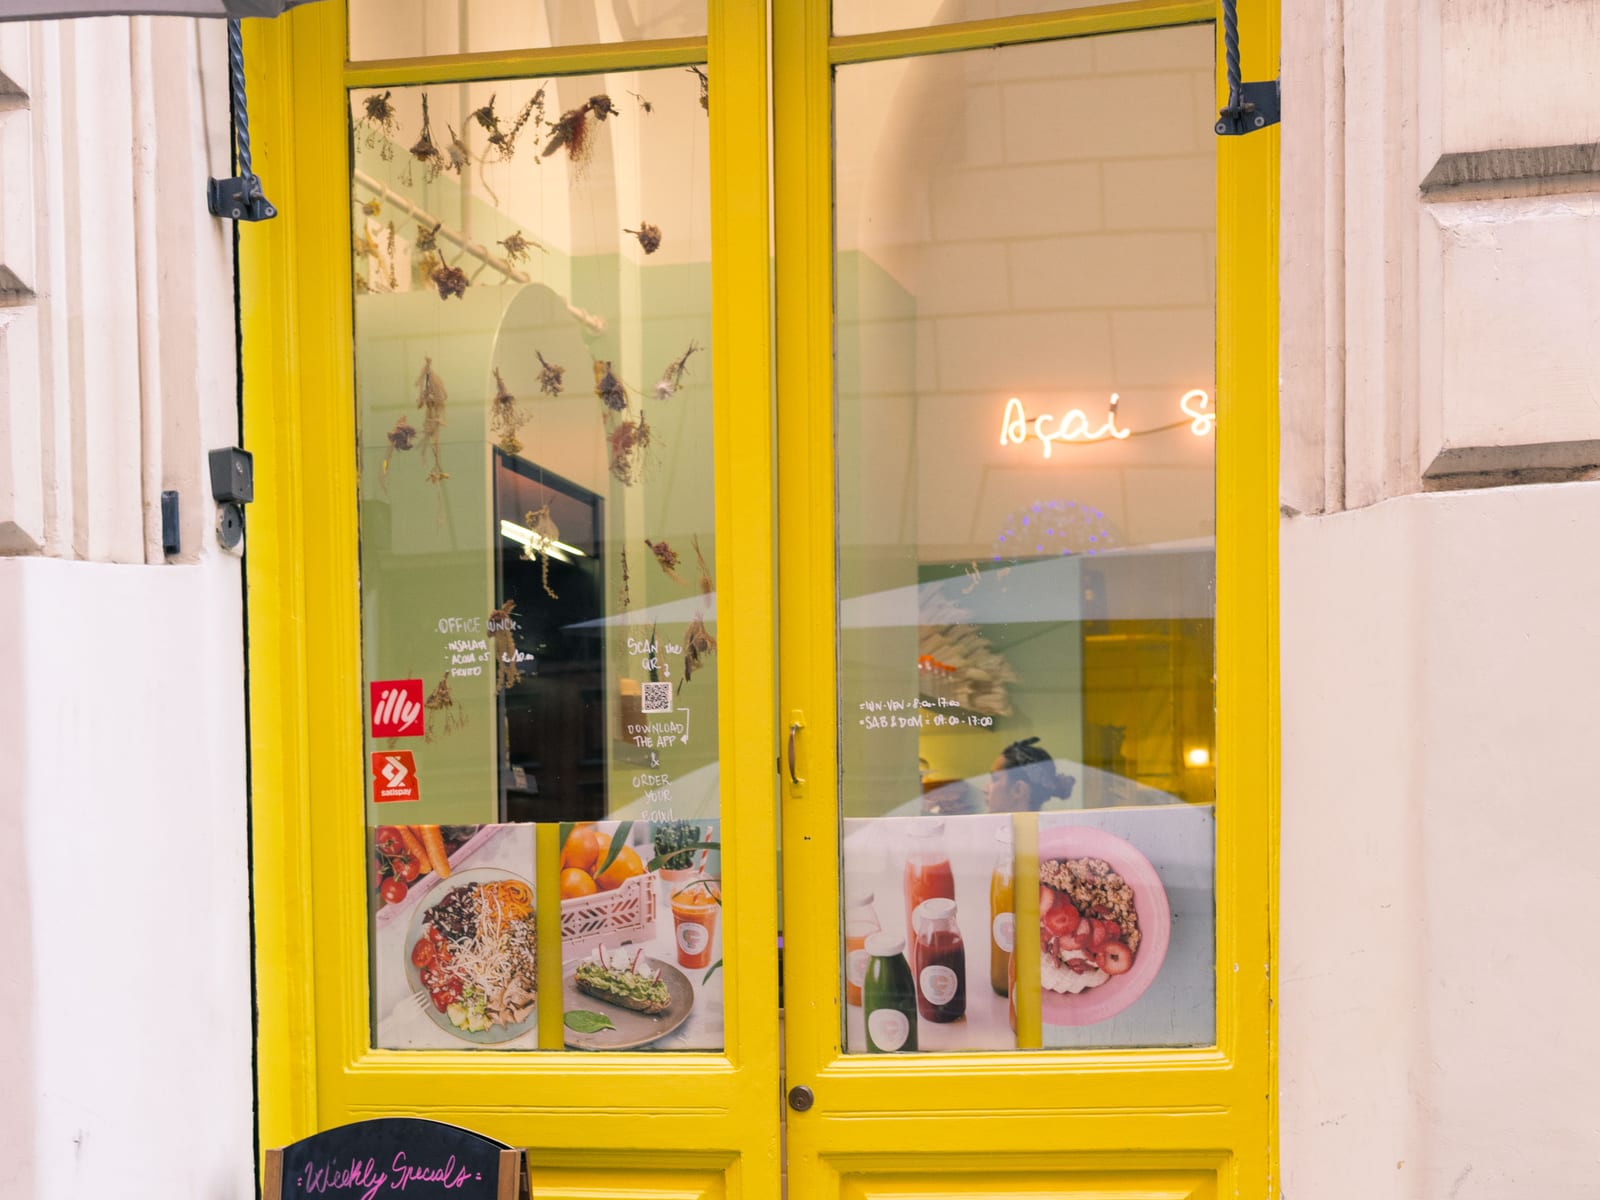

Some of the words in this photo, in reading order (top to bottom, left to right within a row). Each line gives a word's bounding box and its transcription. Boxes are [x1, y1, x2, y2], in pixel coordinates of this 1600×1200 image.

[999, 393, 1131, 459] Açai
[438, 617, 481, 634] OFFICE
[627, 638, 658, 655] SCAN
[374, 688, 420, 732] illy
[628, 722, 683, 734] DOWNLOAD
[633, 736, 653, 748] THE
[657, 736, 676, 748] APP
[632, 774, 671, 788] ORDER
[644, 790, 672, 803] YOUR
[391, 1151, 472, 1191] Specials
